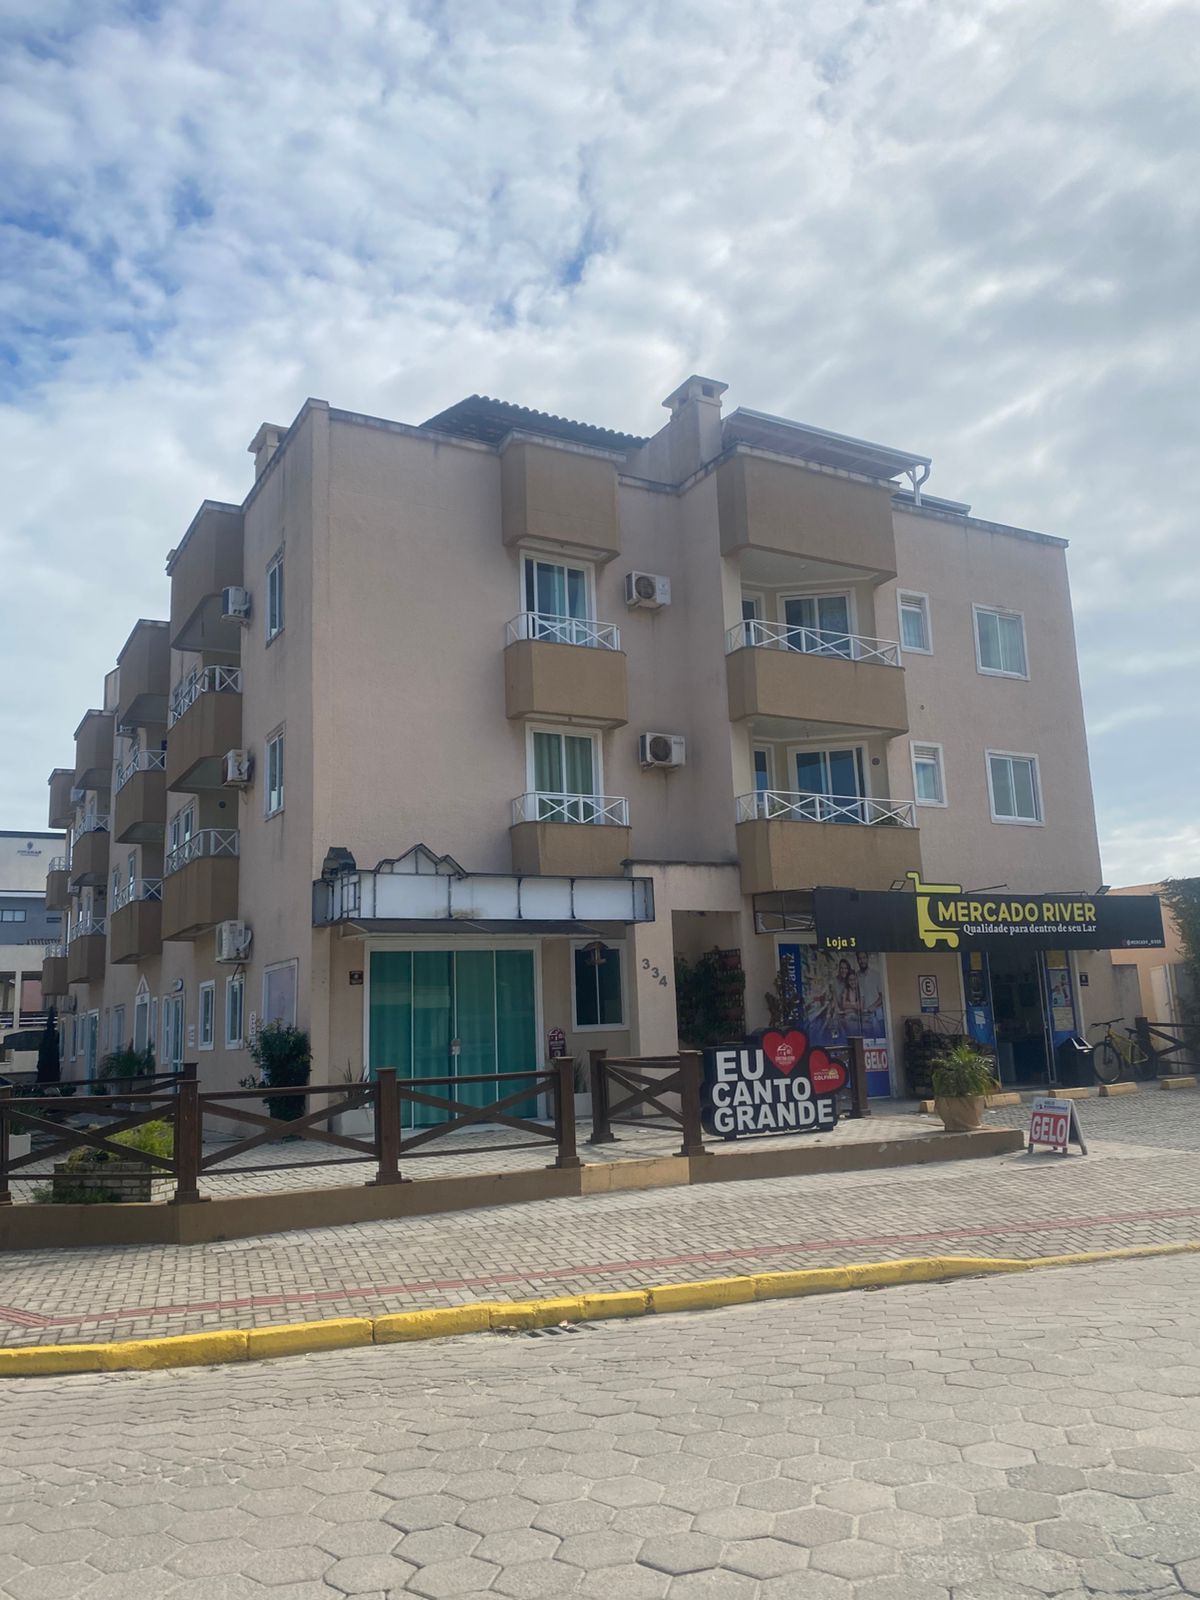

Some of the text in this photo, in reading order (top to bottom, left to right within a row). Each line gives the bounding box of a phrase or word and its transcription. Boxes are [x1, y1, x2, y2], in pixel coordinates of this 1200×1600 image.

[938, 901, 1097, 922] MERCADO RIVER
[963, 923, 1097, 936] Qualidade para dentro de seu Lar
[826, 936, 856, 950] Loja 3
[642, 958, 668, 987] 334
[925, 981, 932, 992] E
[716, 1049, 764, 1082] EU
[864, 1051, 888, 1069] GELO
[712, 1077, 811, 1108] CANTO
[714, 1099, 834, 1132] GRANDE
[1032, 1115, 1067, 1143] GELO
